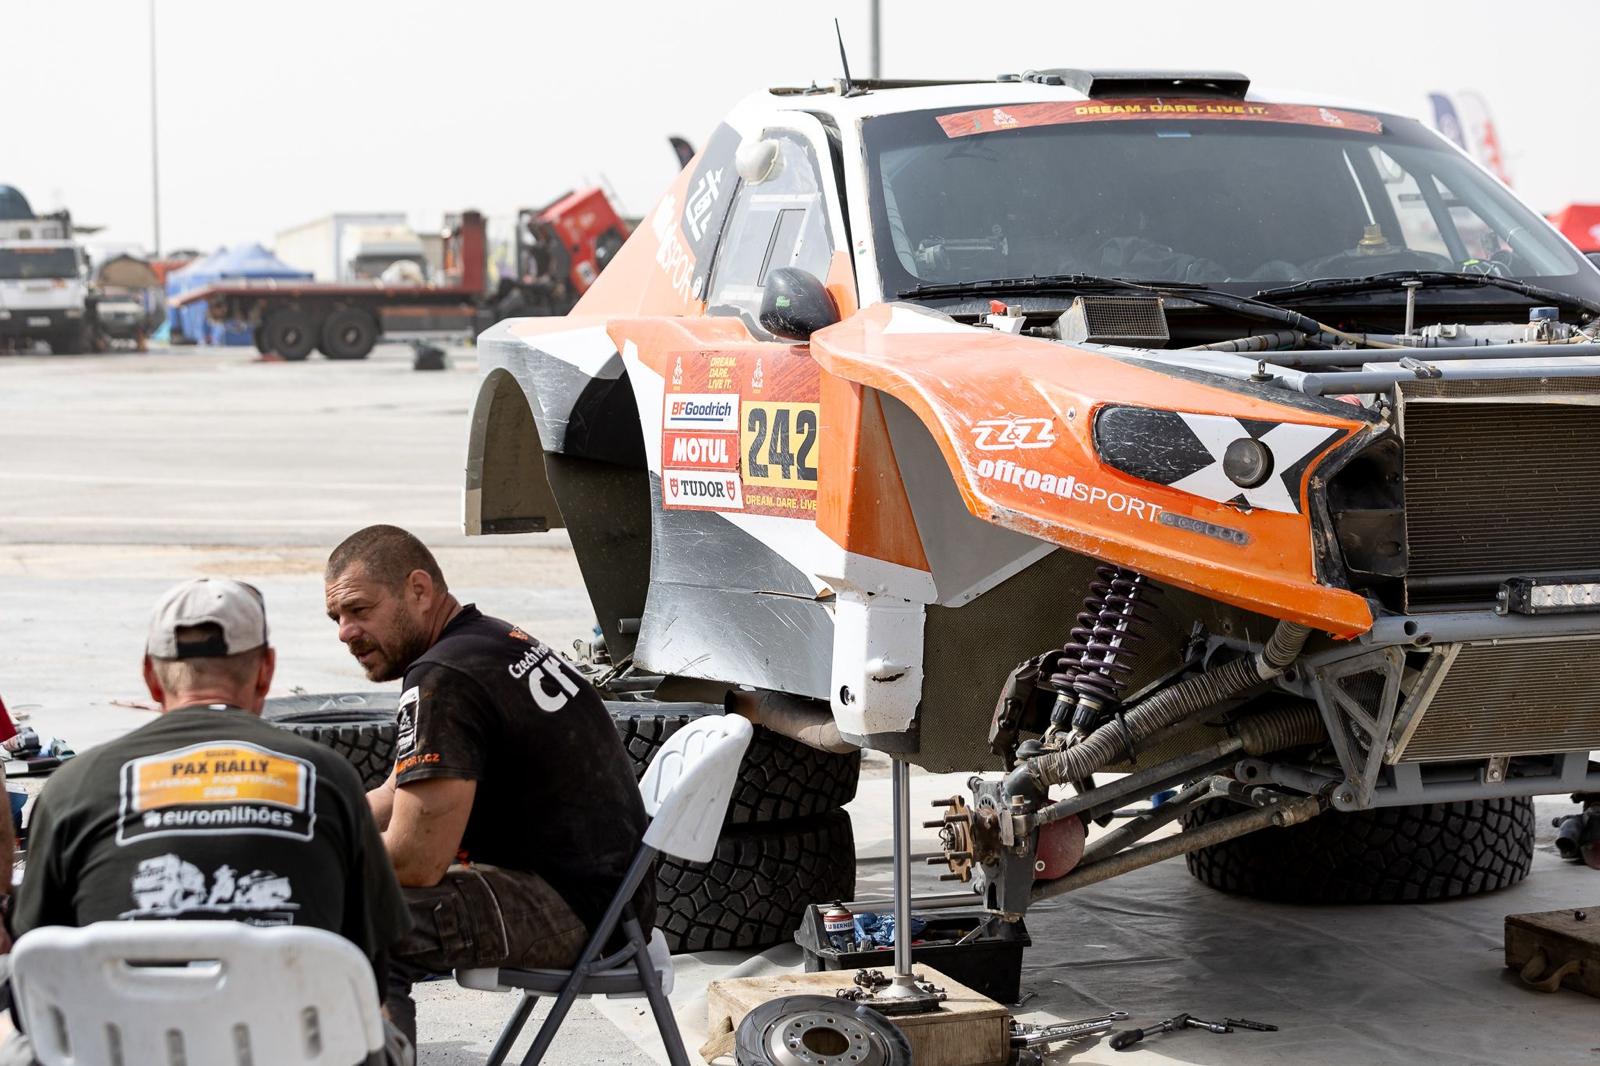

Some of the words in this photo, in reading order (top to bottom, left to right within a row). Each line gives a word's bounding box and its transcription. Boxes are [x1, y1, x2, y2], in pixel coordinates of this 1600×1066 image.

[1075, 104, 1146, 115] DREAM.
[1150, 103, 1203, 113] DARE.
[1206, 105, 1245, 113] LIVE
[1248, 106, 1269, 115] IT.
[710, 357, 736, 368] DREAM.
[708, 367, 729, 378] DARE.
[707, 378, 723, 389] LIVE
[671, 401, 732, 417] BFGoodrich
[672, 437, 729, 464] MOTUL
[748, 407, 818, 481] 242
[680, 478, 726, 498] TUDOR
[977, 457, 1163, 523] offroadSPORT
[745, 494, 775, 507] DREAM.
[776, 496, 799, 509] DARE.
[800, 498, 817, 511] LIVE
[508, 650, 540, 679] Czech
[172, 761, 209, 776] PAX
[214, 759, 270, 774] RALLY
